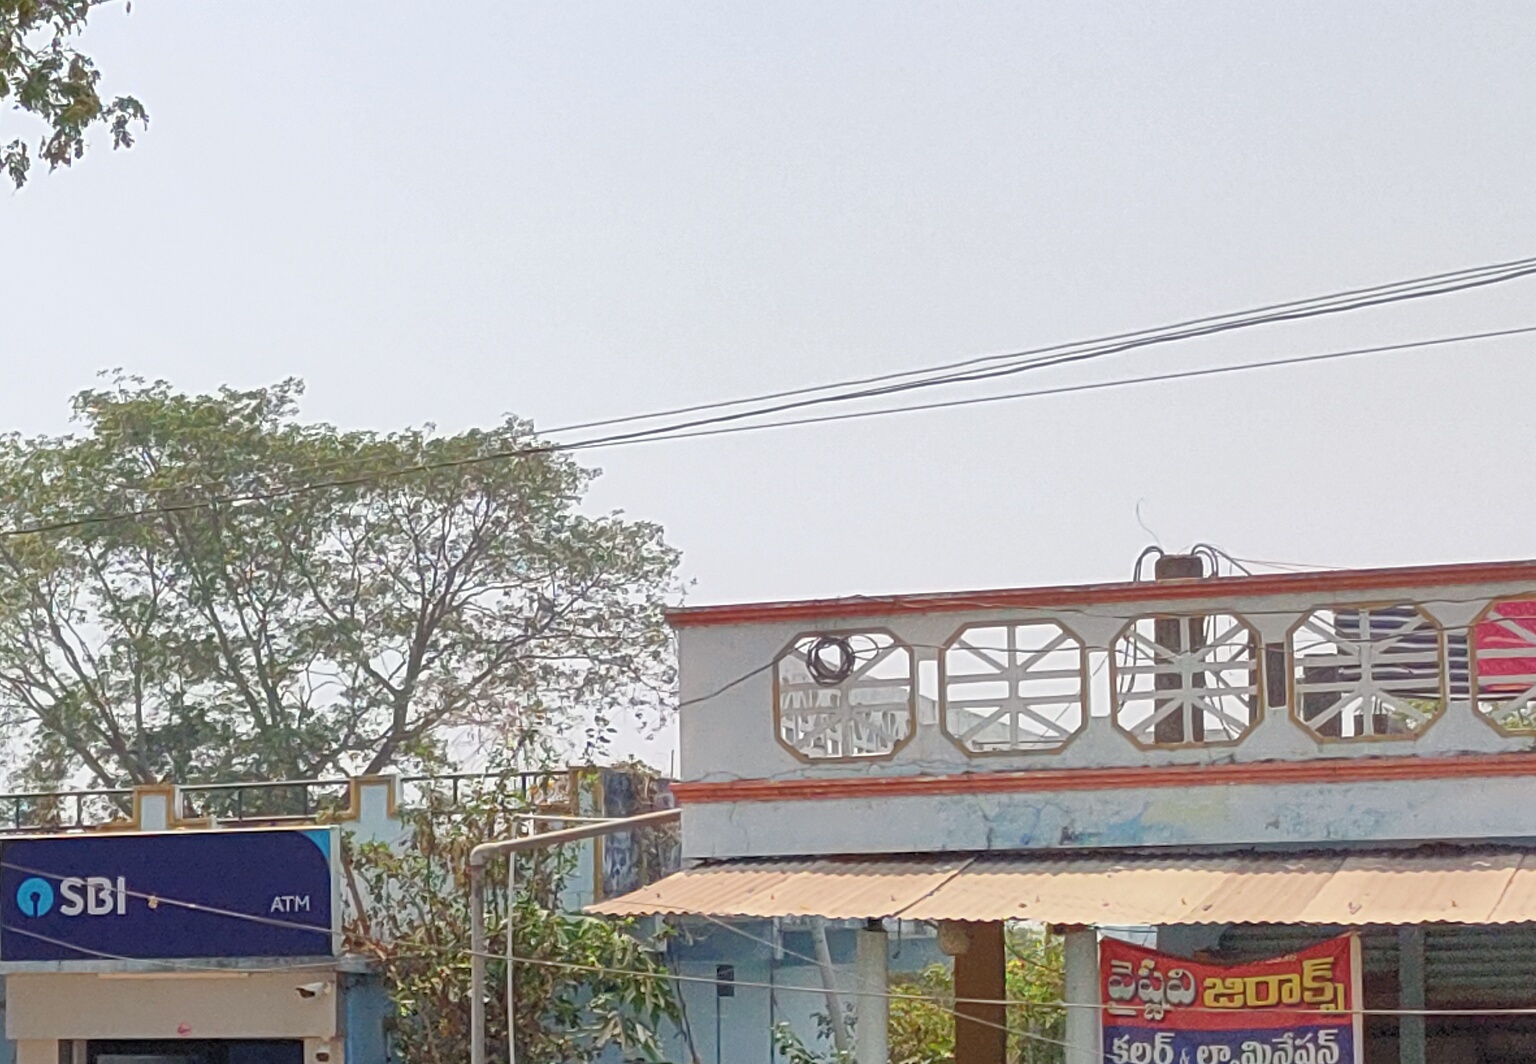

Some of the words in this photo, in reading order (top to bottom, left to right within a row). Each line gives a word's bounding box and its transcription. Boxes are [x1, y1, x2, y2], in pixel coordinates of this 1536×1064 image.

[59, 876, 126, 916] SBI
[271, 896, 310, 913] ATM
[1108, 958, 1196, 1021] వైష్ణవి
